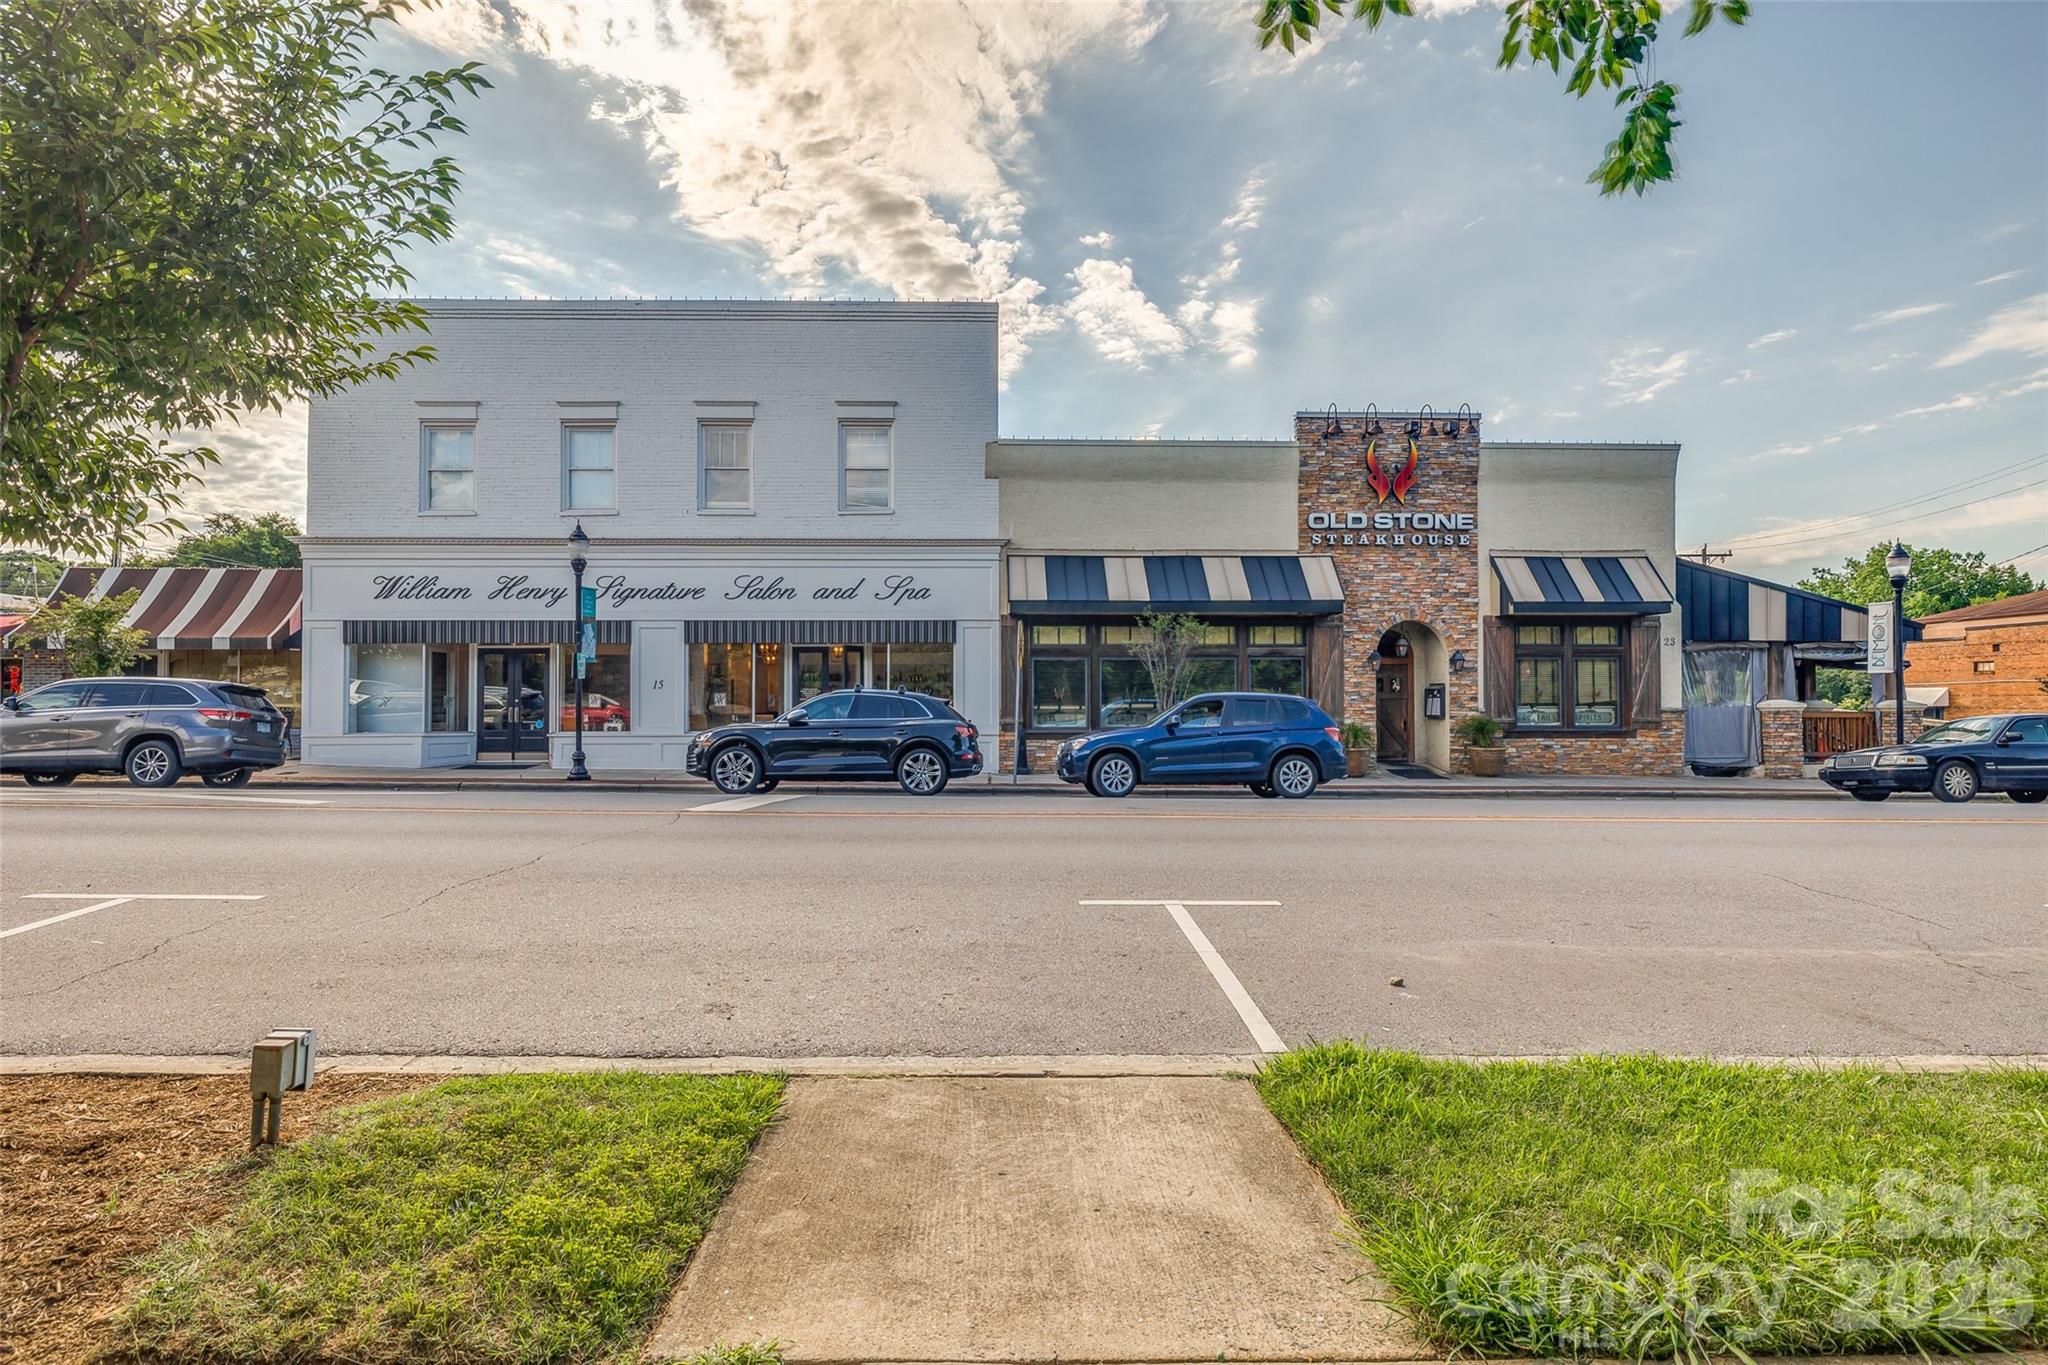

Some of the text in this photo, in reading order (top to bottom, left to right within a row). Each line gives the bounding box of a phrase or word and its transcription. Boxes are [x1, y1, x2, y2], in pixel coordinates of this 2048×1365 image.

[1308, 512, 1475, 530] OLD STONE
[1311, 534, 1470, 546] STEAKHOUSE
[373, 575, 472, 600] William
[488, 575, 568, 608] Henry
[595, 575, 706, 608] Signature
[724, 574, 797, 600] Salon
[812, 577, 866, 600] and
[874, 575, 931, 606] Spa
[1663, 636, 1676, 647] 23
[653, 679, 664, 690] 15
